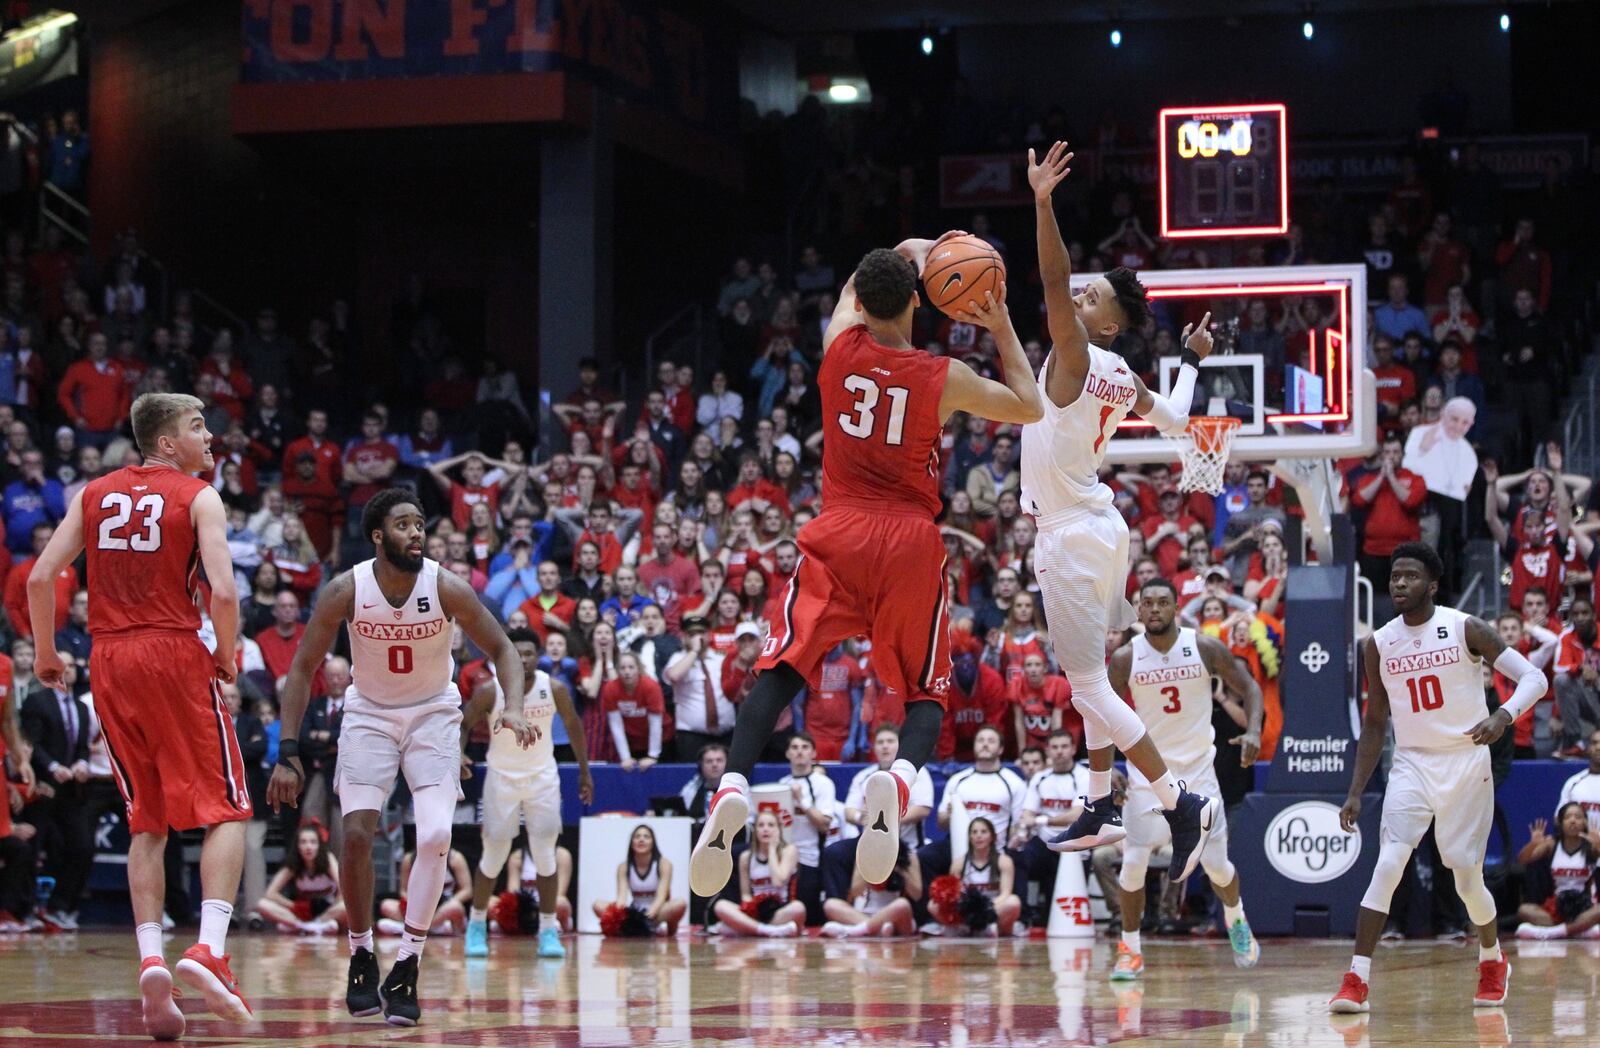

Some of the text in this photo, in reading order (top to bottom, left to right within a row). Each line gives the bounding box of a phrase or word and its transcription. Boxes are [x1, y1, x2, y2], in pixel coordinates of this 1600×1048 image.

[838, 373, 910, 446] 31
[1094, 405, 1115, 454] 1
[98, 491, 165, 553] 23
[417, 597, 430, 613] 5
[356, 618, 443, 640] DAYTON
[1437, 626, 1449, 639] 5
[388, 645, 413, 674] 0
[1182, 647, 1192, 657] 5
[1386, 646, 1460, 675] DAYTON
[1134, 664, 1201, 686] DAYTON
[1160, 686, 1181, 714] 3
[1406, 674, 1444, 713] 10
[1283, 735, 1349, 754] Premier
[1288, 755, 1345, 772] Health
[1278, 816, 1352, 871] Kroger
